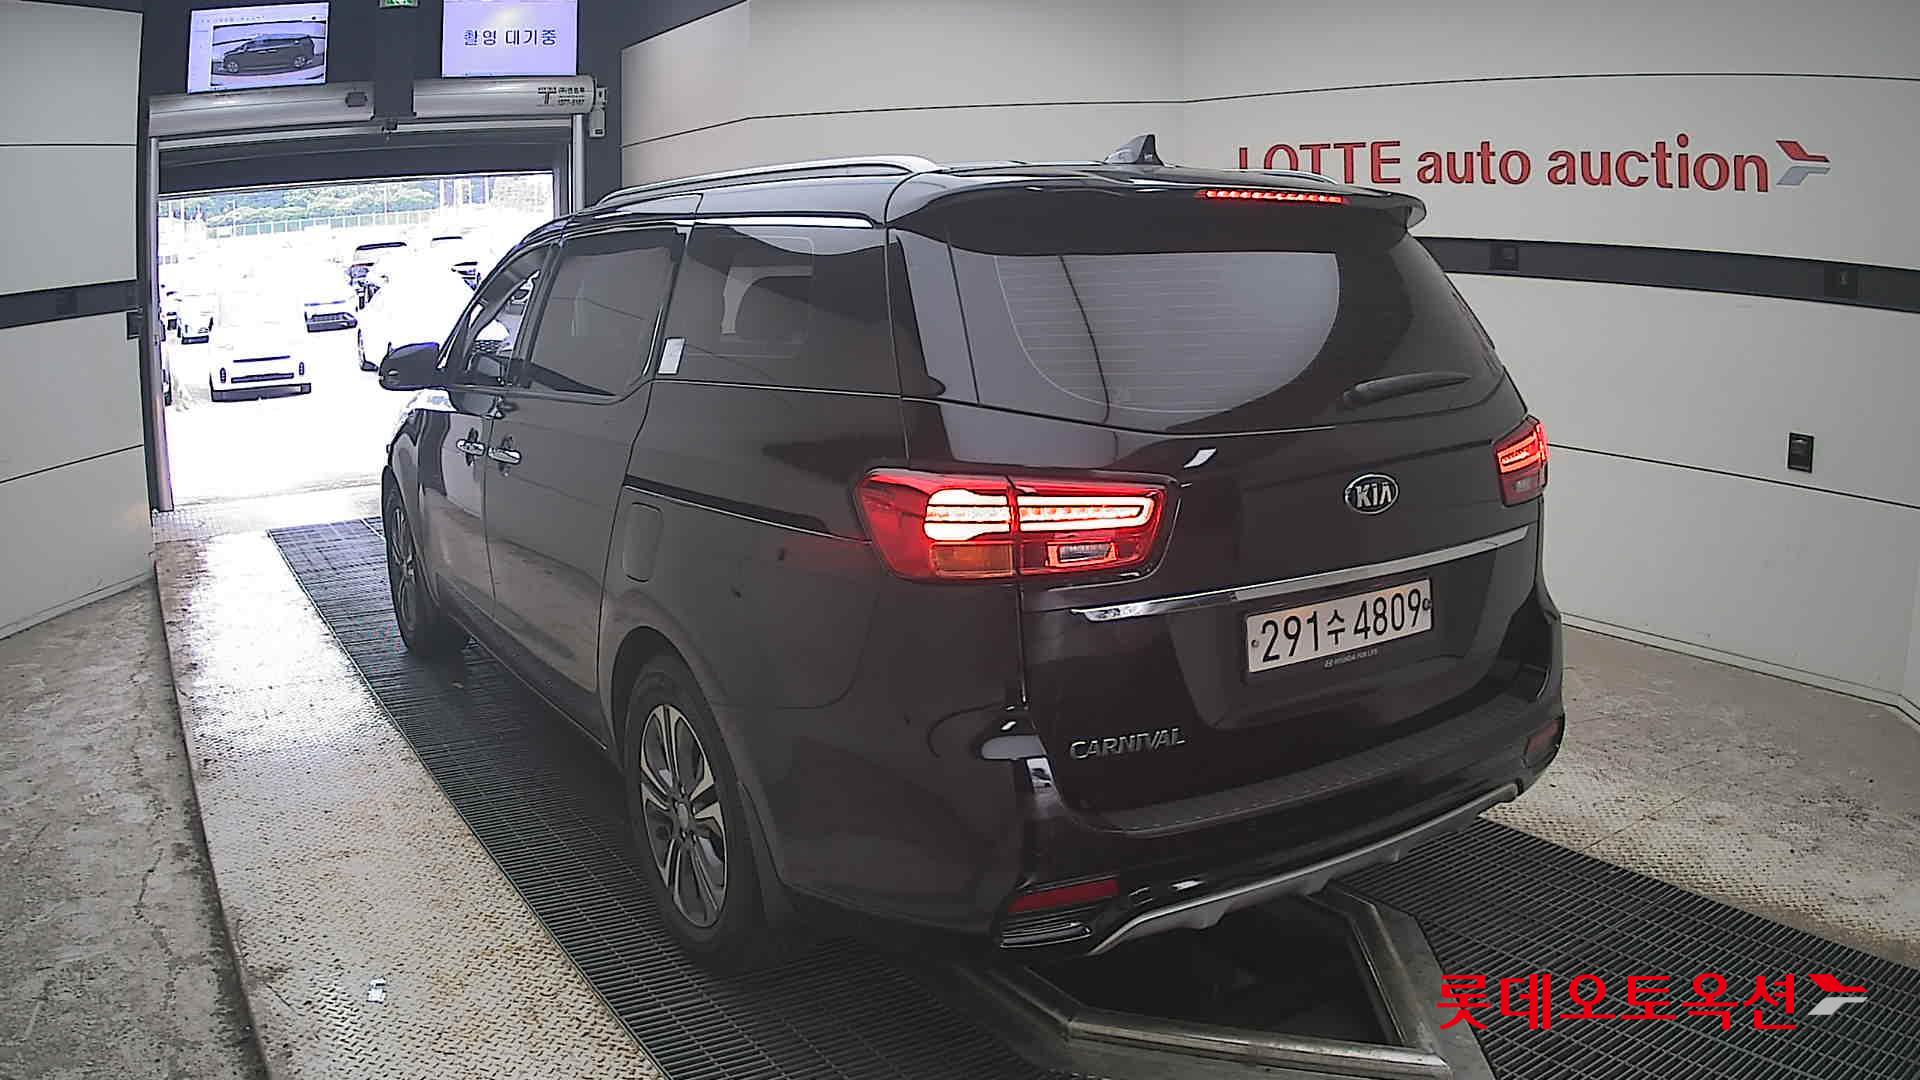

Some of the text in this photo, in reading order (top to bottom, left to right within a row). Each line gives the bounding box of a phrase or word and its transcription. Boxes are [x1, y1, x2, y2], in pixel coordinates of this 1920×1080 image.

[504, 29, 557, 46] 대기중
[1416, 140, 1532, 185] auto
[1546, 133, 1769, 193] auction
[1353, 480, 1394, 509] KIA
[1260, 587, 1422, 663] 291수4809
[1069, 727, 1186, 759] CARNIVAL
